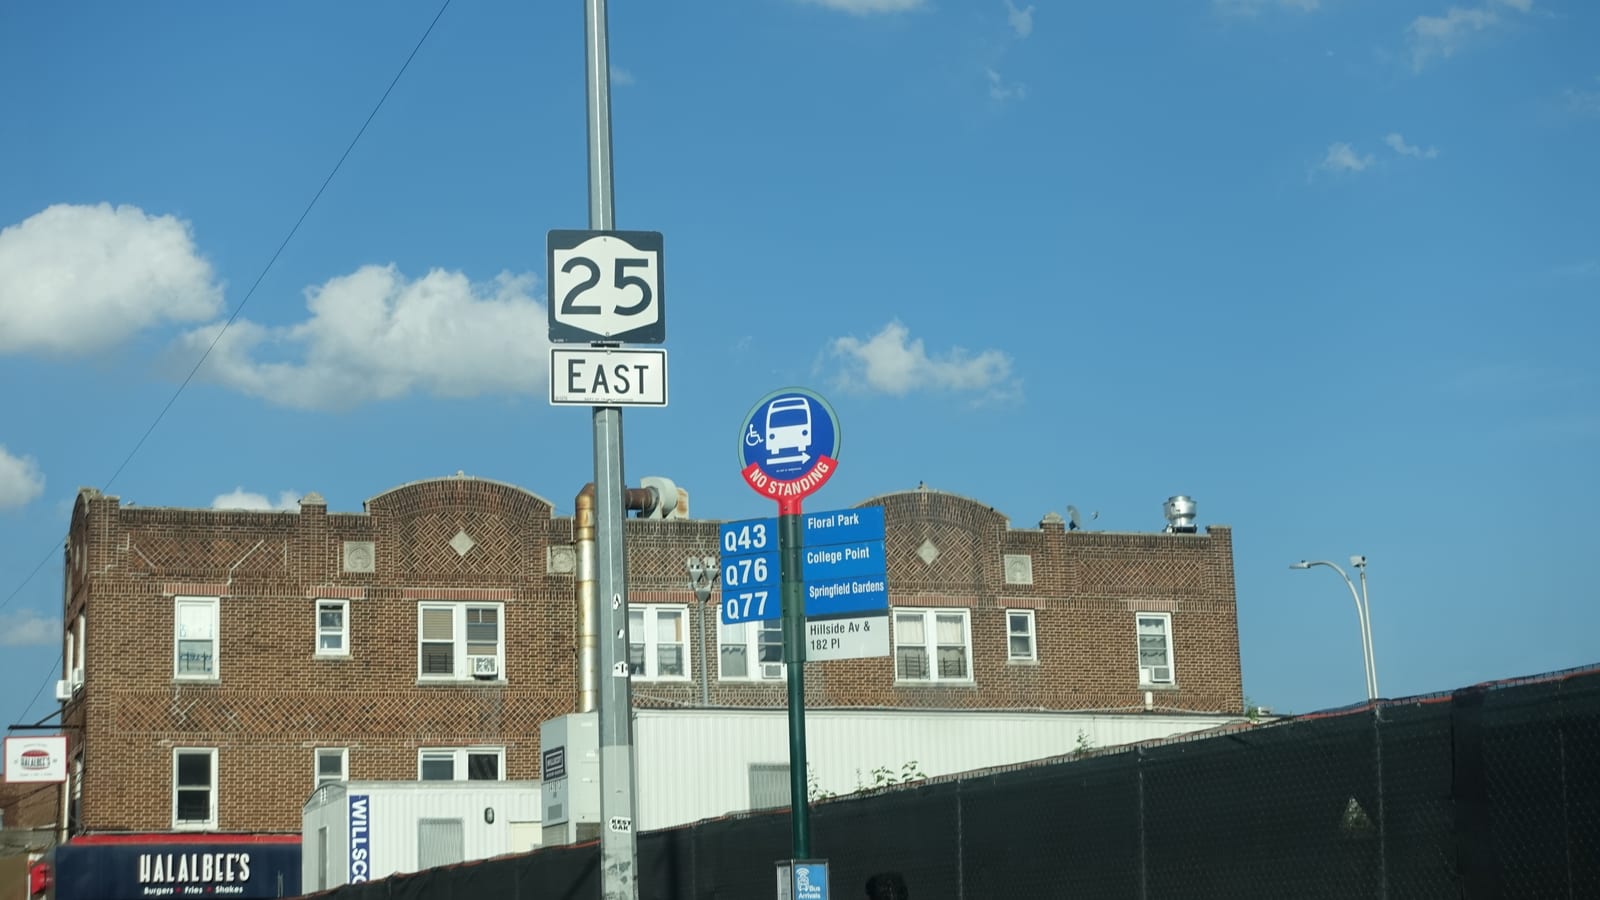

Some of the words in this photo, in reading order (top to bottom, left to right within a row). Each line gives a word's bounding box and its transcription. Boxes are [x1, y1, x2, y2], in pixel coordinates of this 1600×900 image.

[561, 256, 653, 316] 25
[568, 358, 649, 395] EAST
[750, 468, 767, 488] NO
[768, 462, 829, 496] STANDING
[807, 515, 835, 530] Floral
[837, 512, 860, 527] Park
[724, 523, 768, 553] Q43
[807, 550, 843, 565] College
[845, 547, 870, 560] Point
[725, 557, 769, 587] Q76
[808, 583, 851, 599] Springfield
[852, 580, 885, 594] Gardens
[726, 591, 769, 620] Q77
[809, 621, 846, 636] Hillside
[848, 621, 860, 633] Av
[863, 621, 871, 632] &
[810, 640, 828, 651] 182
[831, 638, 841, 650] Pl
[139, 853, 250, 883] HALALBEE'S
[143, 886, 174, 897] Burgers
[184, 885, 203, 895] Fries
[215, 885, 243, 895] Shakes
